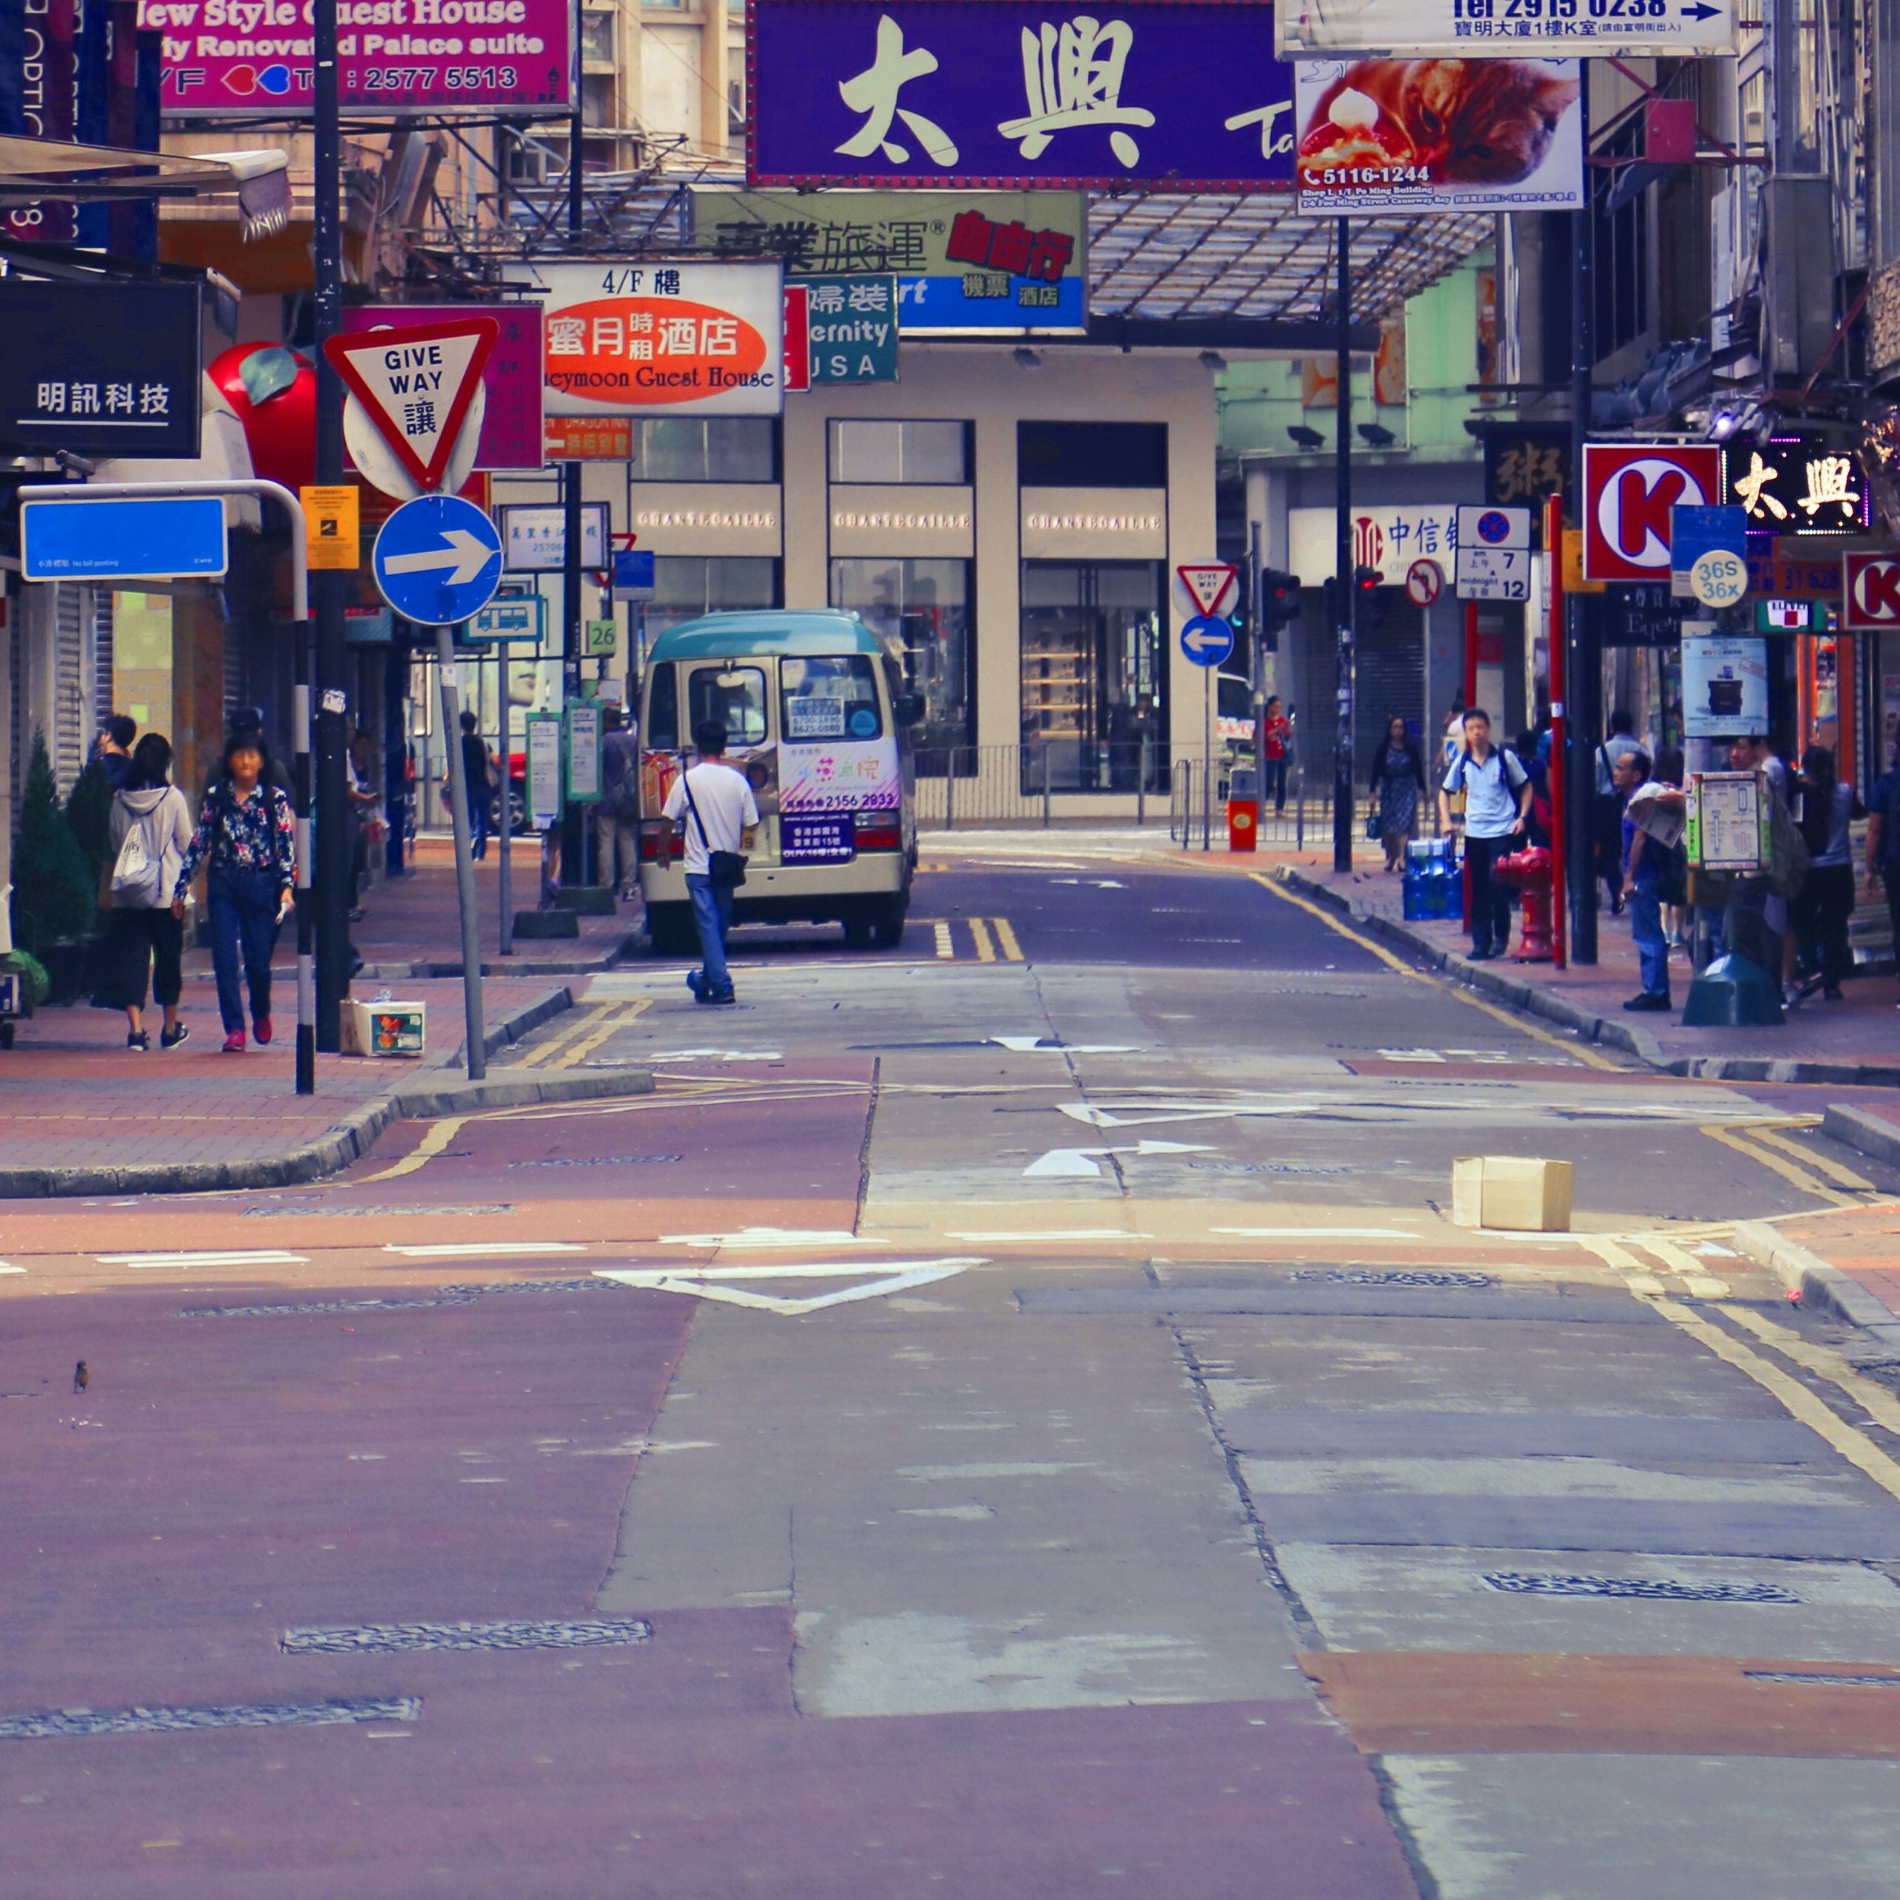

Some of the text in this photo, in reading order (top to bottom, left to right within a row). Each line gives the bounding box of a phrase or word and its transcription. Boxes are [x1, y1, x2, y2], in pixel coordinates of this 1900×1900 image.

[364, 34, 463, 56] Palace
[469, 35, 545, 57] suite
[365, 68, 517, 91] 2577 5513
[833, 15, 1156, 168] 太興
[1323, 165, 1430, 186] 5116-1244
[1361, 197, 1390, 207] Street
[1393, 185, 1434, 197] Building
[945, 209, 1075, 284] 自由行
[601, 269, 645, 296] 4/F
[1018, 285, 1060, 308] 酒店
[810, 320, 890, 349] ernity
[384, 345, 443, 371] GIVE
[388, 370, 443, 396] WAY
[635, 365, 700, 389] Guest
[706, 365, 775, 389] House
[36, 382, 171, 415] 明訊科技
[403, 400, 437, 436] 讓
[1733, 451, 1862, 521] 太興
[1502, 552, 1515, 570] 7
[1502, 581, 1525, 598] 12
[592, 627, 616, 646] 26
[826, 795, 859, 808] 2156
